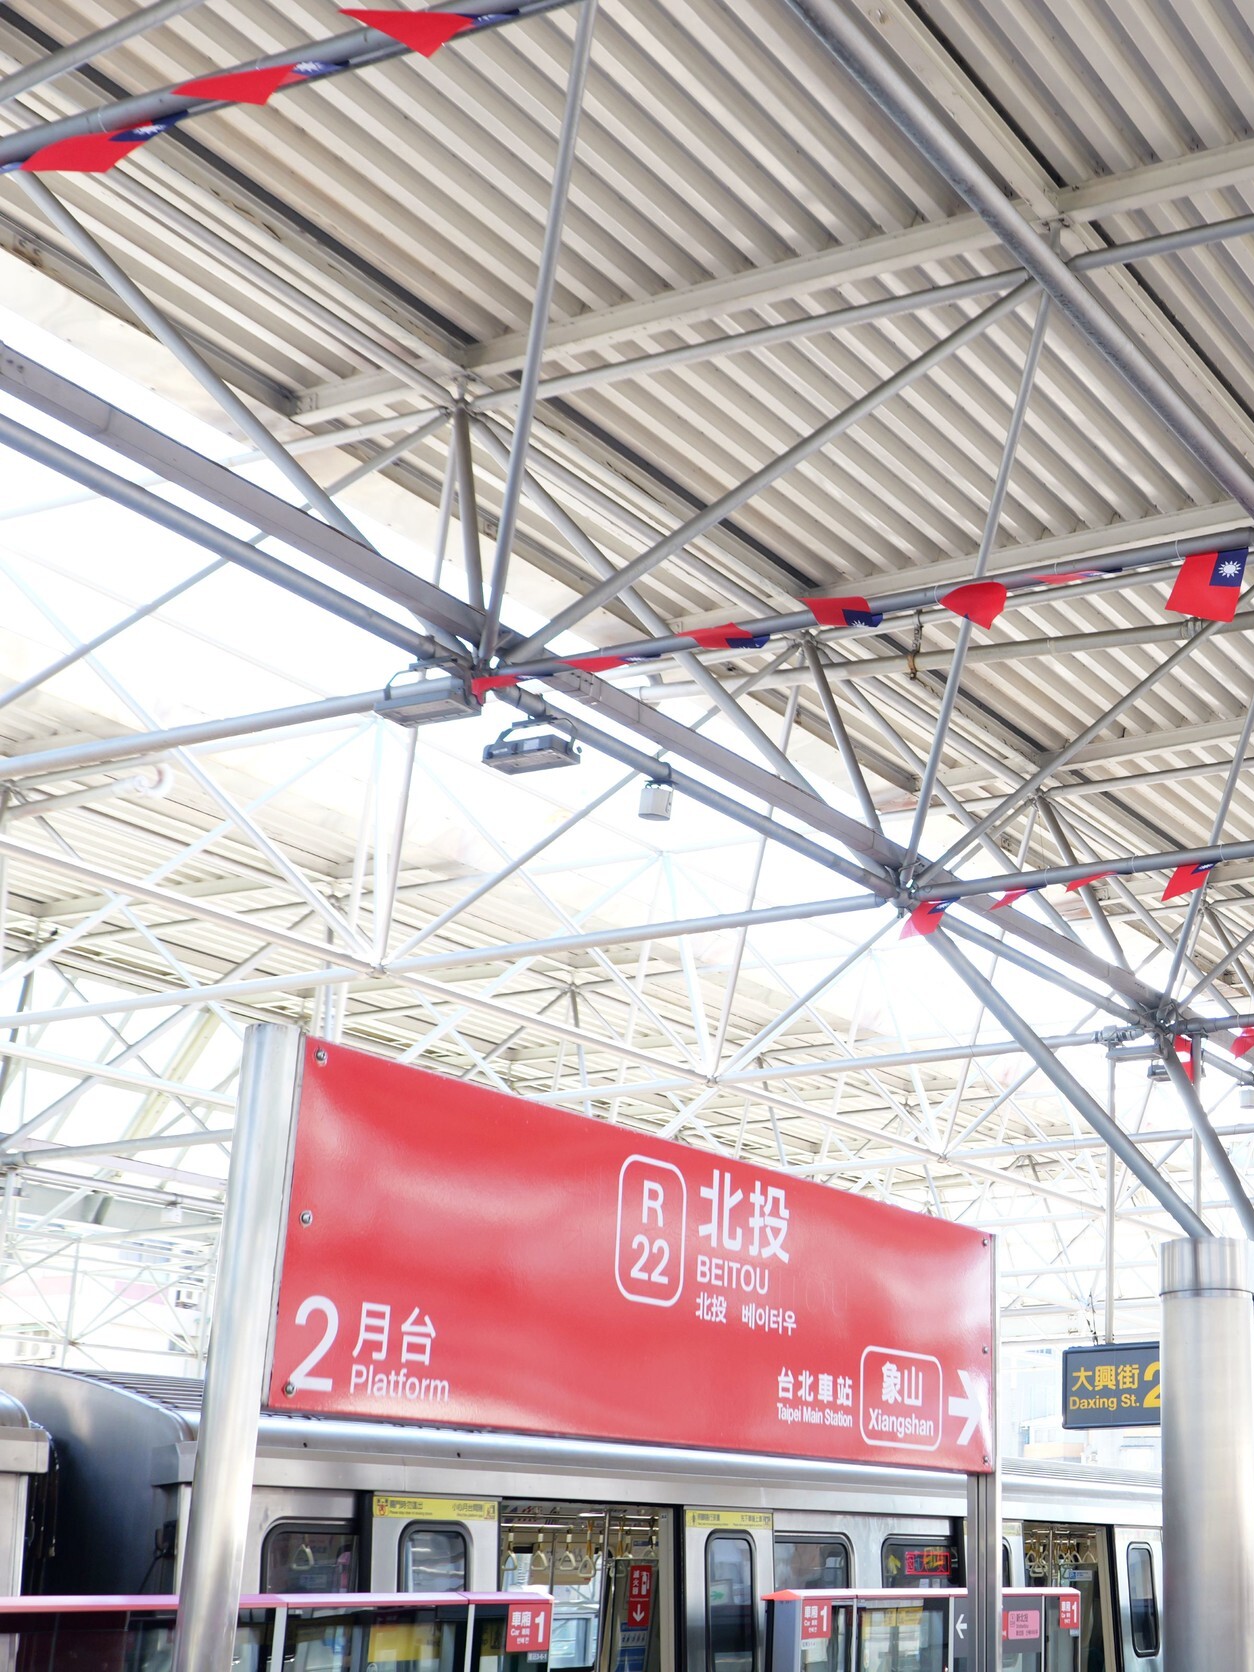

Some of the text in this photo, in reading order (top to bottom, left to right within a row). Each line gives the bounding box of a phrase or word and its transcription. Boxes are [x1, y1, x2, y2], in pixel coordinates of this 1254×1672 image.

[642, 1179, 664, 1228] R
[698, 1168, 790, 1264] 北投
[630, 1233, 670, 1285] 22
[696, 1254, 769, 1295] BEITOU
[352, 1301, 436, 1366] 月台
[695, 1291, 797, 1336] 北投 베이터우
[289, 1294, 339, 1393] 2
[349, 1363, 449, 1402] Platform
[777, 1366, 853, 1408] 台北車站
[881, 1360, 923, 1407] 象山
[1071, 1363, 1139, 1392] 大興街
[1142, 1361, 1161, 1408] 2
[776, 1402, 853, 1428] Taipei Main Station
[1069, 1393, 1139, 1411] Daxing St.
[868, 1408, 934, 1438] Xiangshan
[510, 1628, 520, 1636] Car
[512, 1611, 532, 1627] 車廂
[534, 1611, 545, 1643] 1
[820, 1605, 828, 1632] 1
[1071, 1601, 1077, 1623] 1
